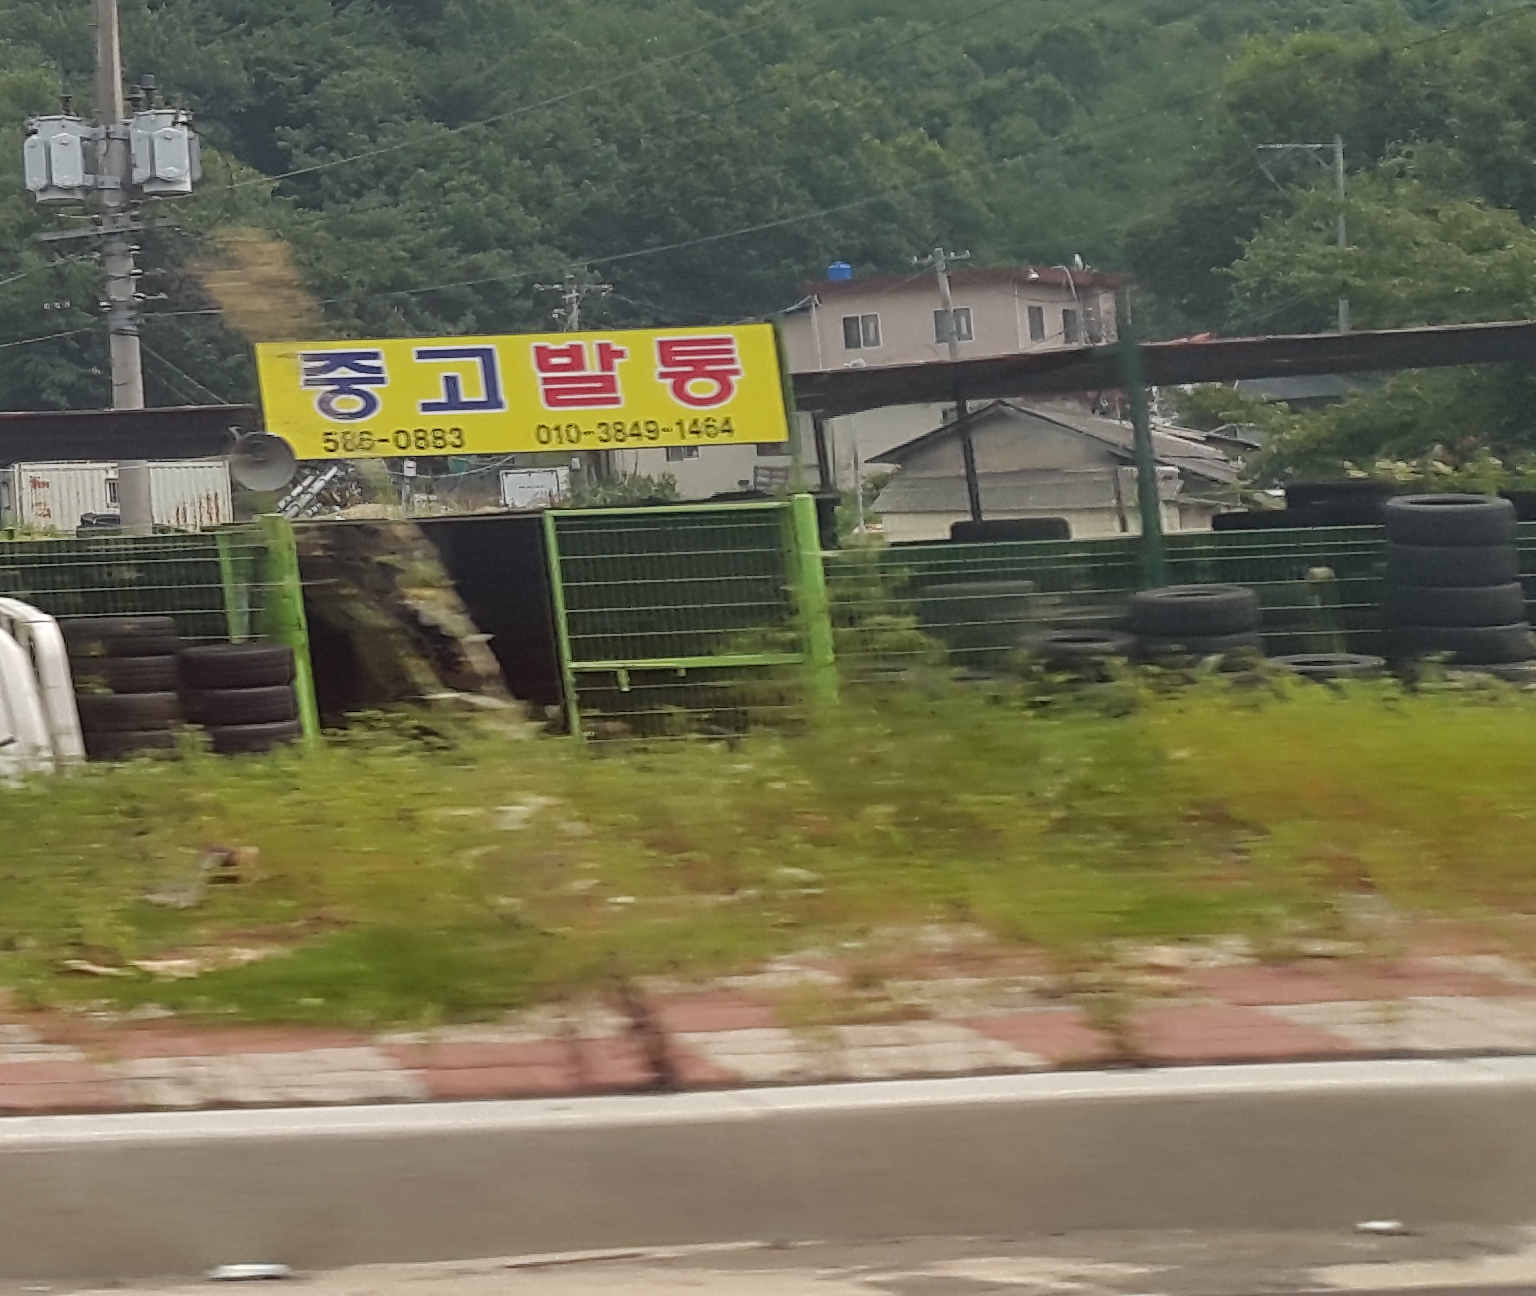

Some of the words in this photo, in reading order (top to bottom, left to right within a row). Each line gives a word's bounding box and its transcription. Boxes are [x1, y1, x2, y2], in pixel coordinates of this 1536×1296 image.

[299, 334, 743, 422] 중고발통
[322, 427, 465, 453] 586-0883
[534, 416, 736, 445] 010-3849-1464
